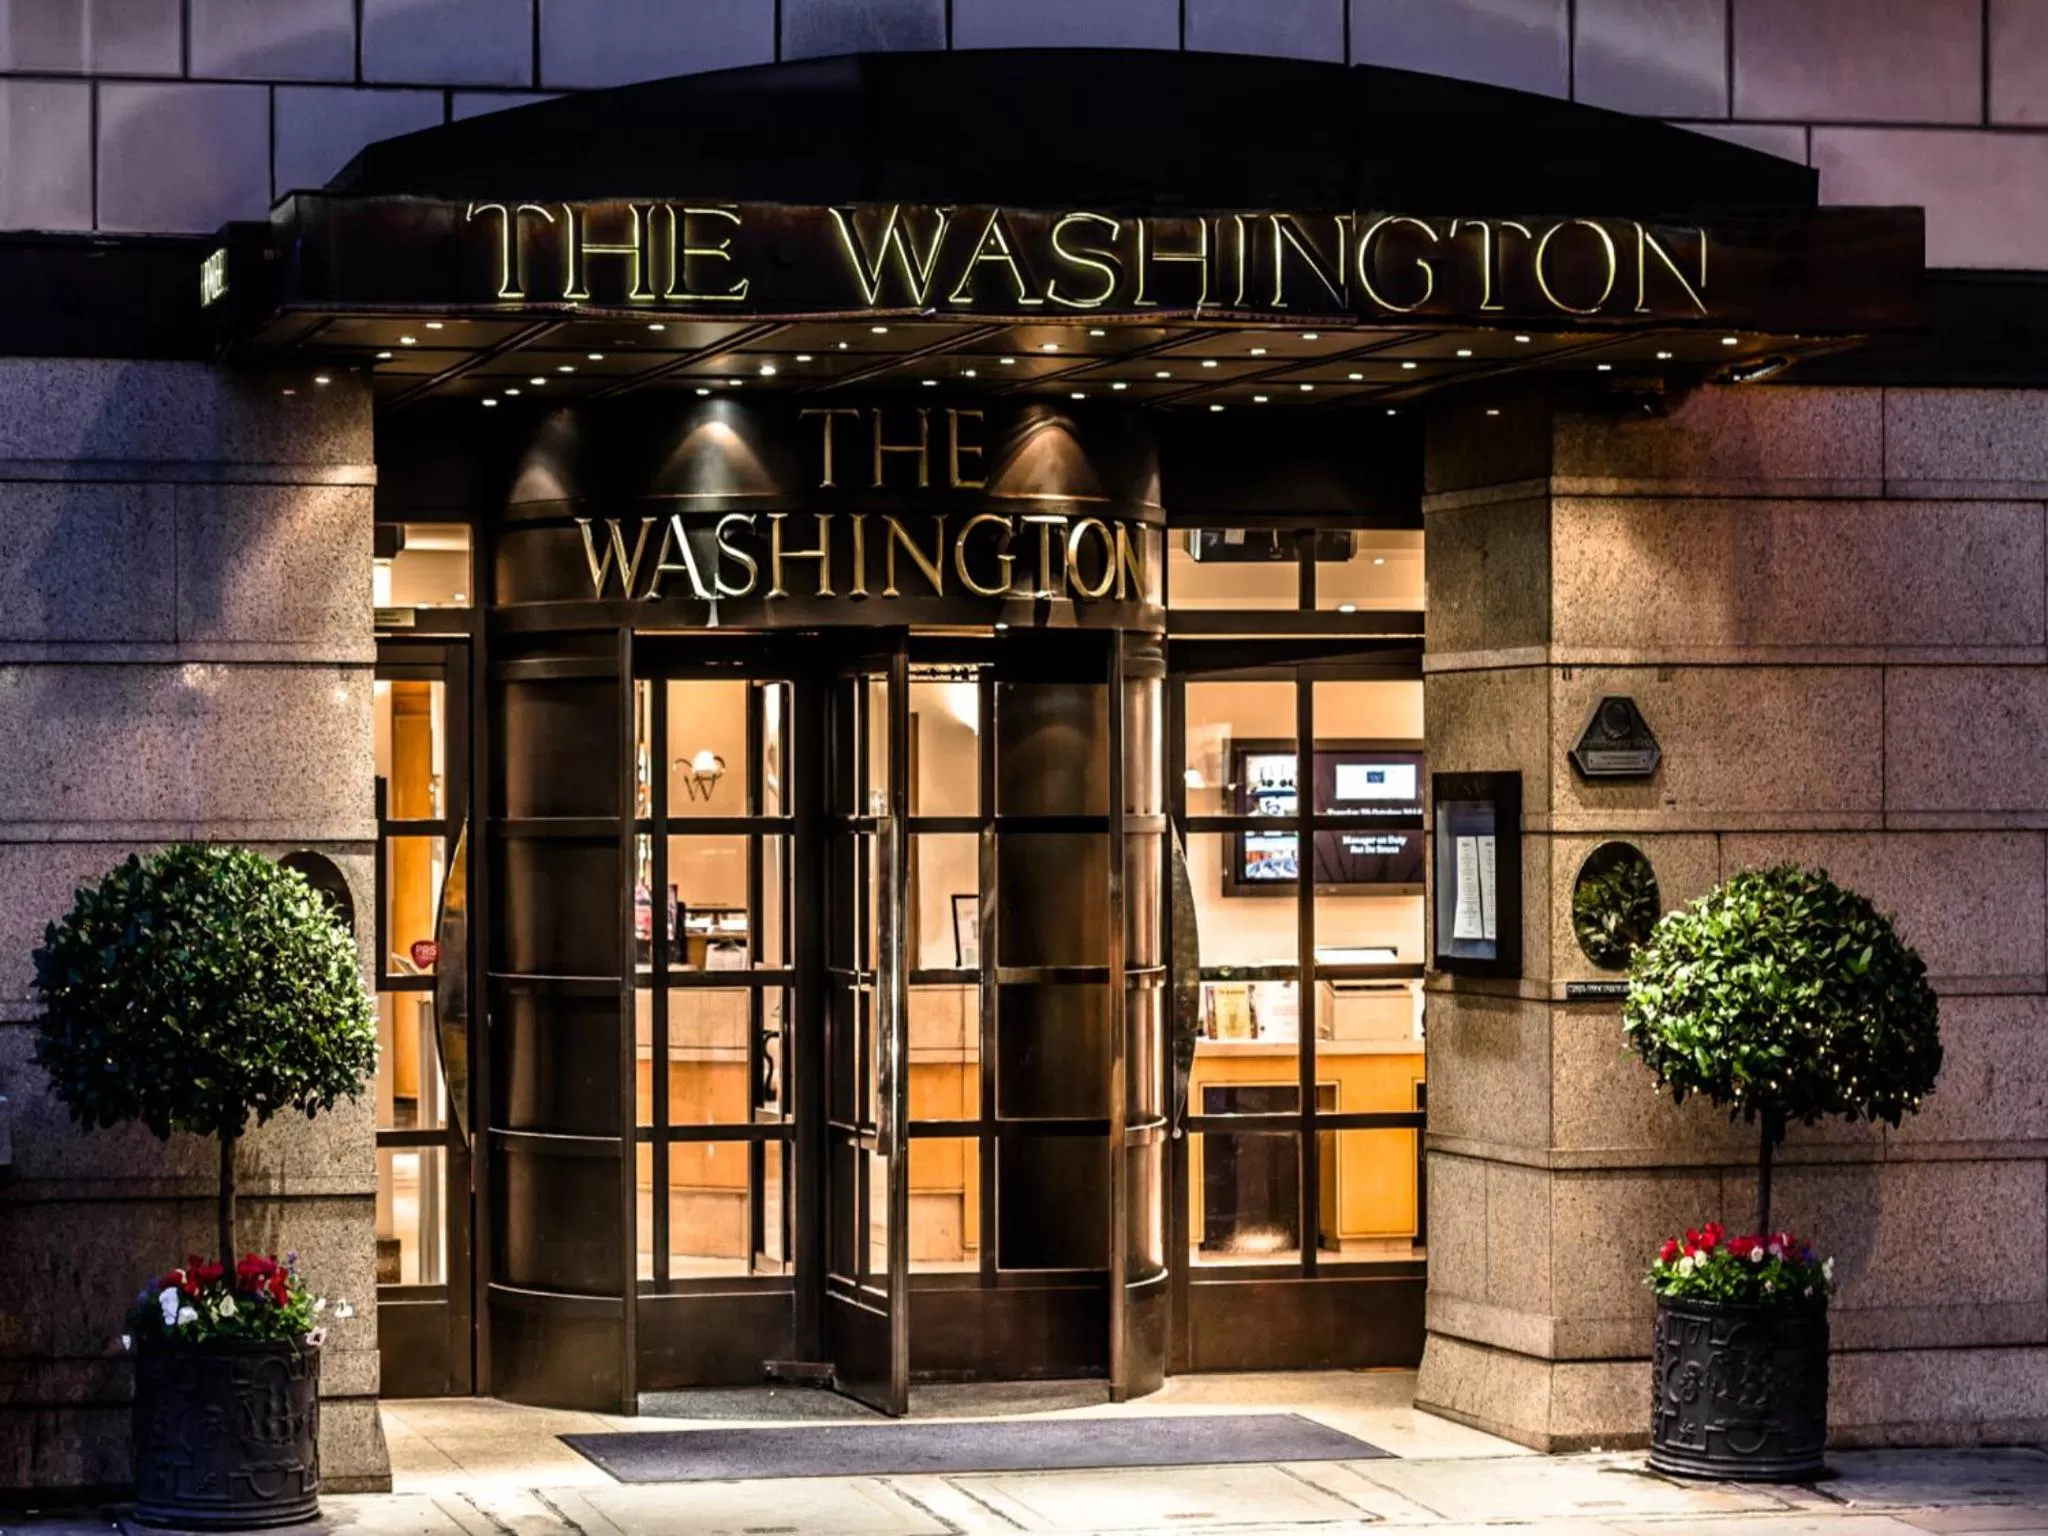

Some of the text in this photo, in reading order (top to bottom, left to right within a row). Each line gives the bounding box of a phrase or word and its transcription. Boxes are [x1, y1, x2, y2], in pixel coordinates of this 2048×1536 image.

[466, 203, 1708, 315] THE WASHINGTON
[799, 407, 988, 489] THE
[574, 512, 1148, 601] WASHINGTON
